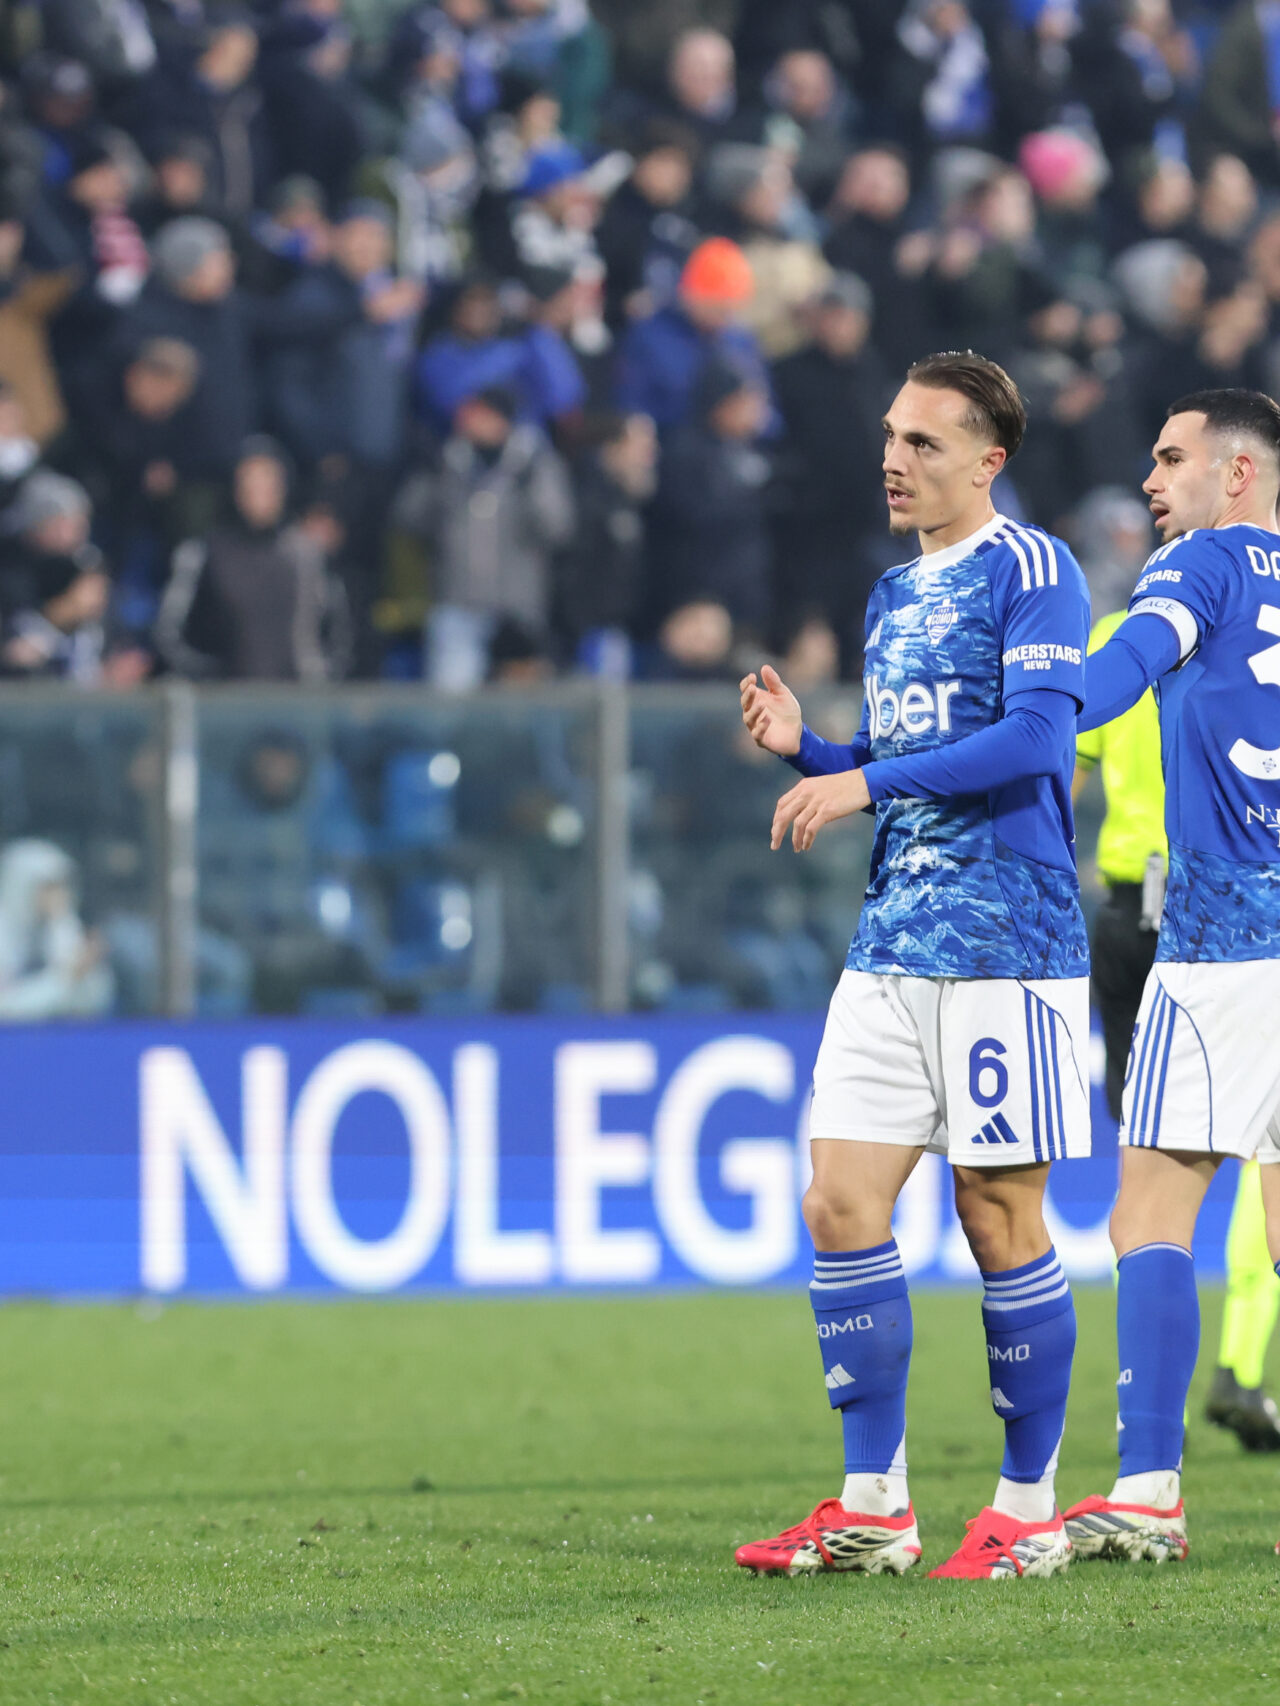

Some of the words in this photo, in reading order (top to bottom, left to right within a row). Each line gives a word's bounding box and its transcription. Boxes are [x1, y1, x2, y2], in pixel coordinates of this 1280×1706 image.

[1023, 660, 1052, 671] NEWS
[969, 1037, 1008, 1108] 6
[816, 1313, 874, 1338] OMO
